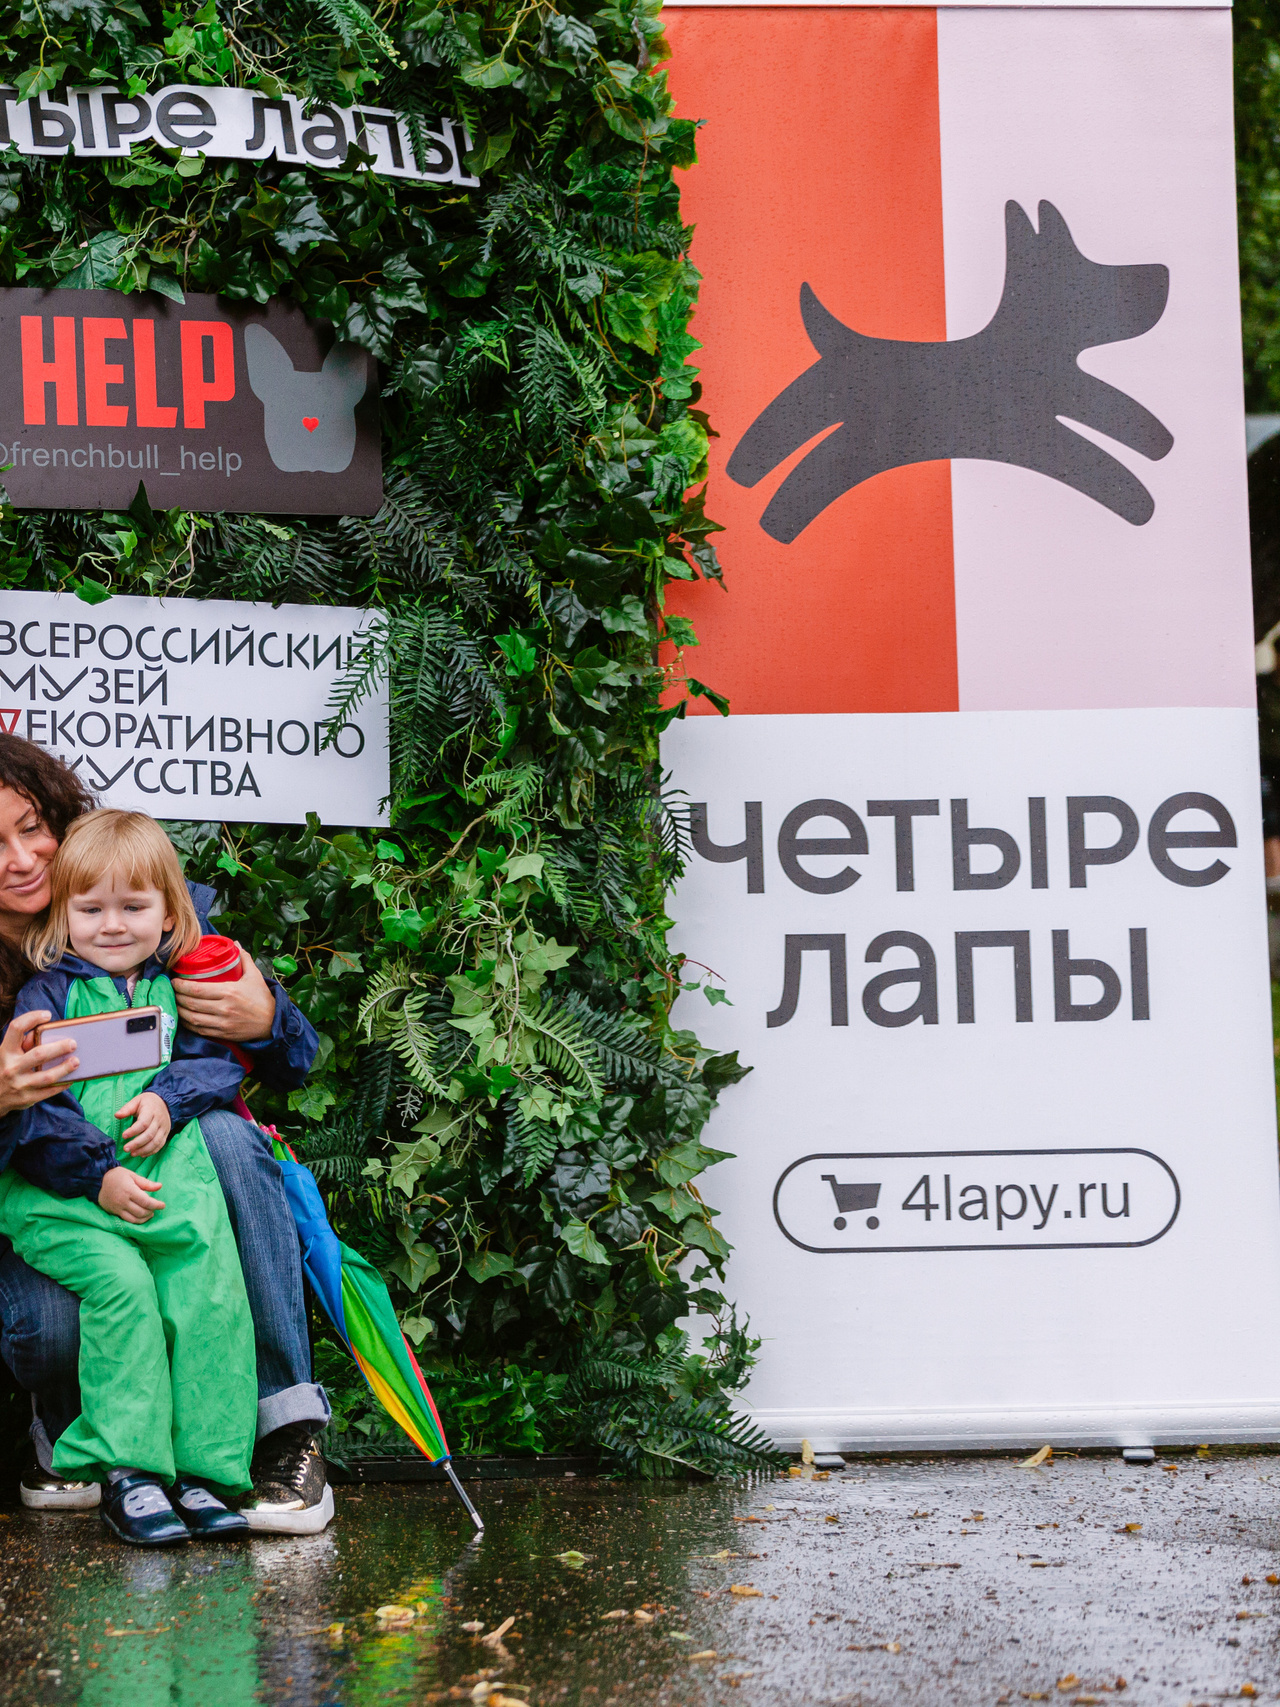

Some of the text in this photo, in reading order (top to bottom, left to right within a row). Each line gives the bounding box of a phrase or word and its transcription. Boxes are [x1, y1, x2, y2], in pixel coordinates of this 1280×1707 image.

[245, 96, 472, 179] лапы
[20, 315, 236, 430] HELP
[59, 754, 262, 798] УССТВА
[689, 791, 1238, 895] четыре
[766, 927, 1151, 1029] лапы
[901, 1173, 1132, 1231] 4lapy.ru
